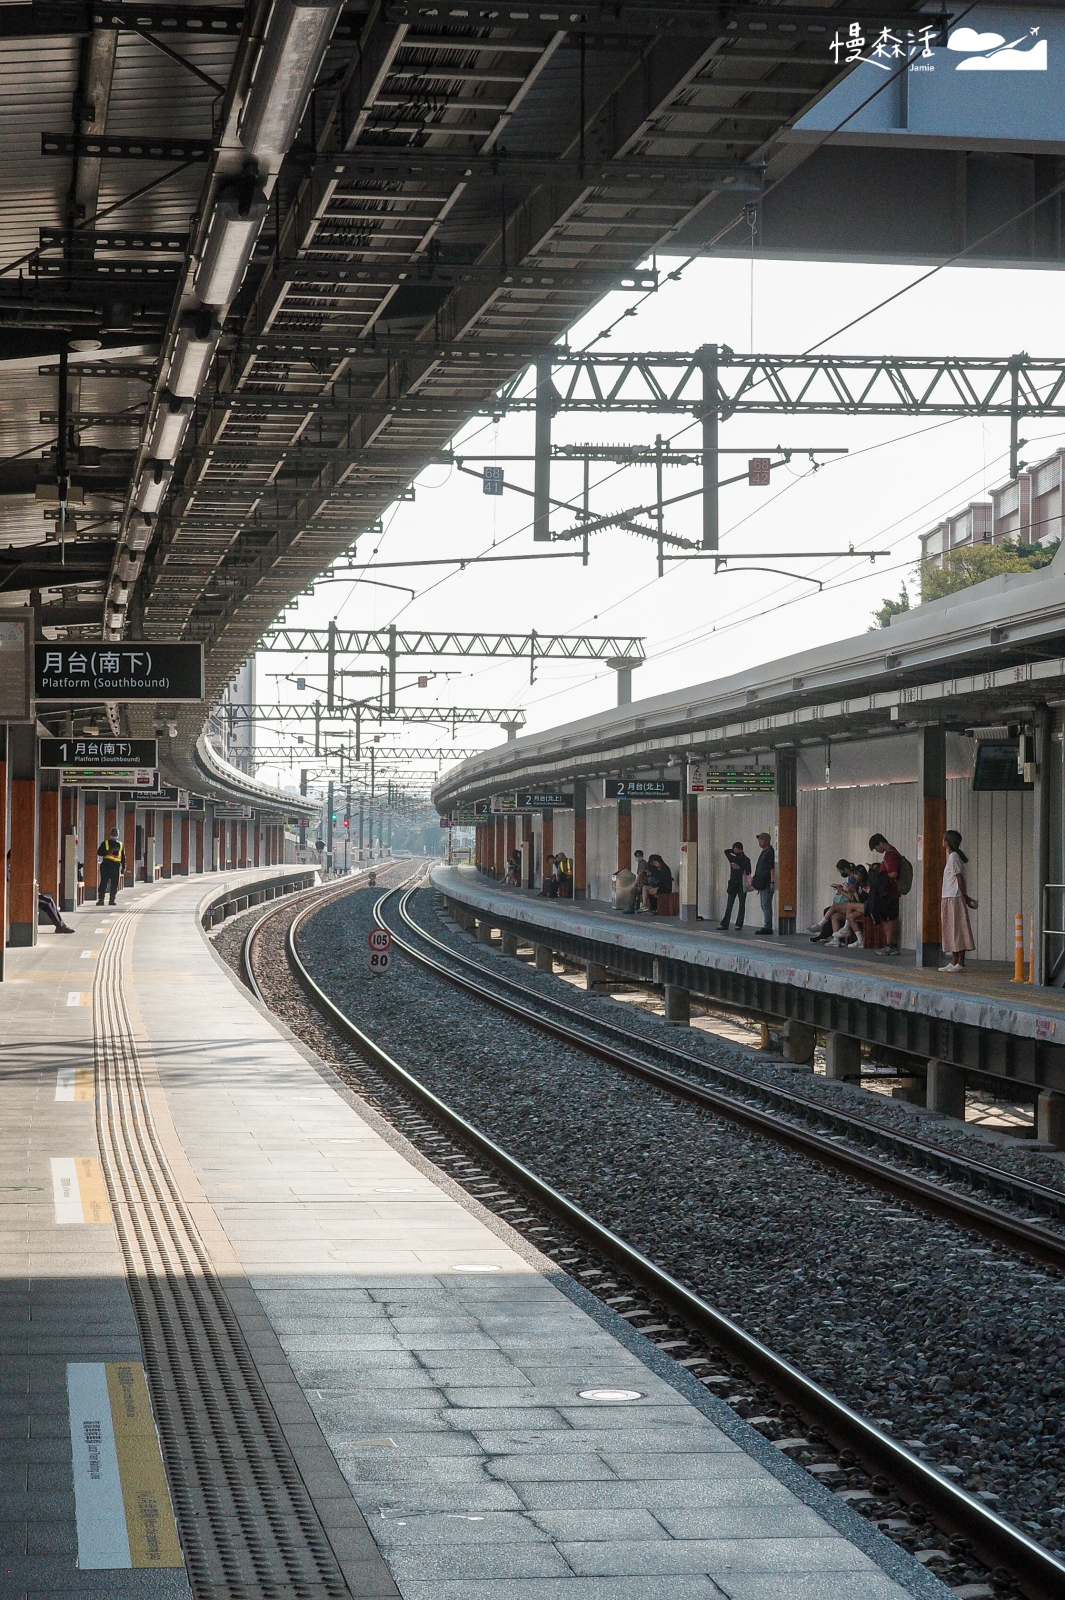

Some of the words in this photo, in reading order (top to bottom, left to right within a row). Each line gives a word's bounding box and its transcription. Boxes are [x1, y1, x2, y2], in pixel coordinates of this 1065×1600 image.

[754, 458, 769, 470] 68
[485, 467, 500, 479] 68
[753, 473, 769, 484] 42
[484, 481, 498, 493] 41
[42, 651, 152, 675] 月台(南下)
[42, 677, 90, 688] Platform
[93, 677, 170, 689] (Southbound)
[59, 743, 68, 762] 1
[74, 742, 132, 756] 月台(南下)
[694, 765, 700, 773] 2
[617, 782, 625, 795] 2
[627, 782, 665, 792] 月台(北上)
[525, 795, 532, 805] 2
[482, 804, 488, 813] 2
[373, 935, 388, 945] 105
[371, 954, 388, 966] 80
